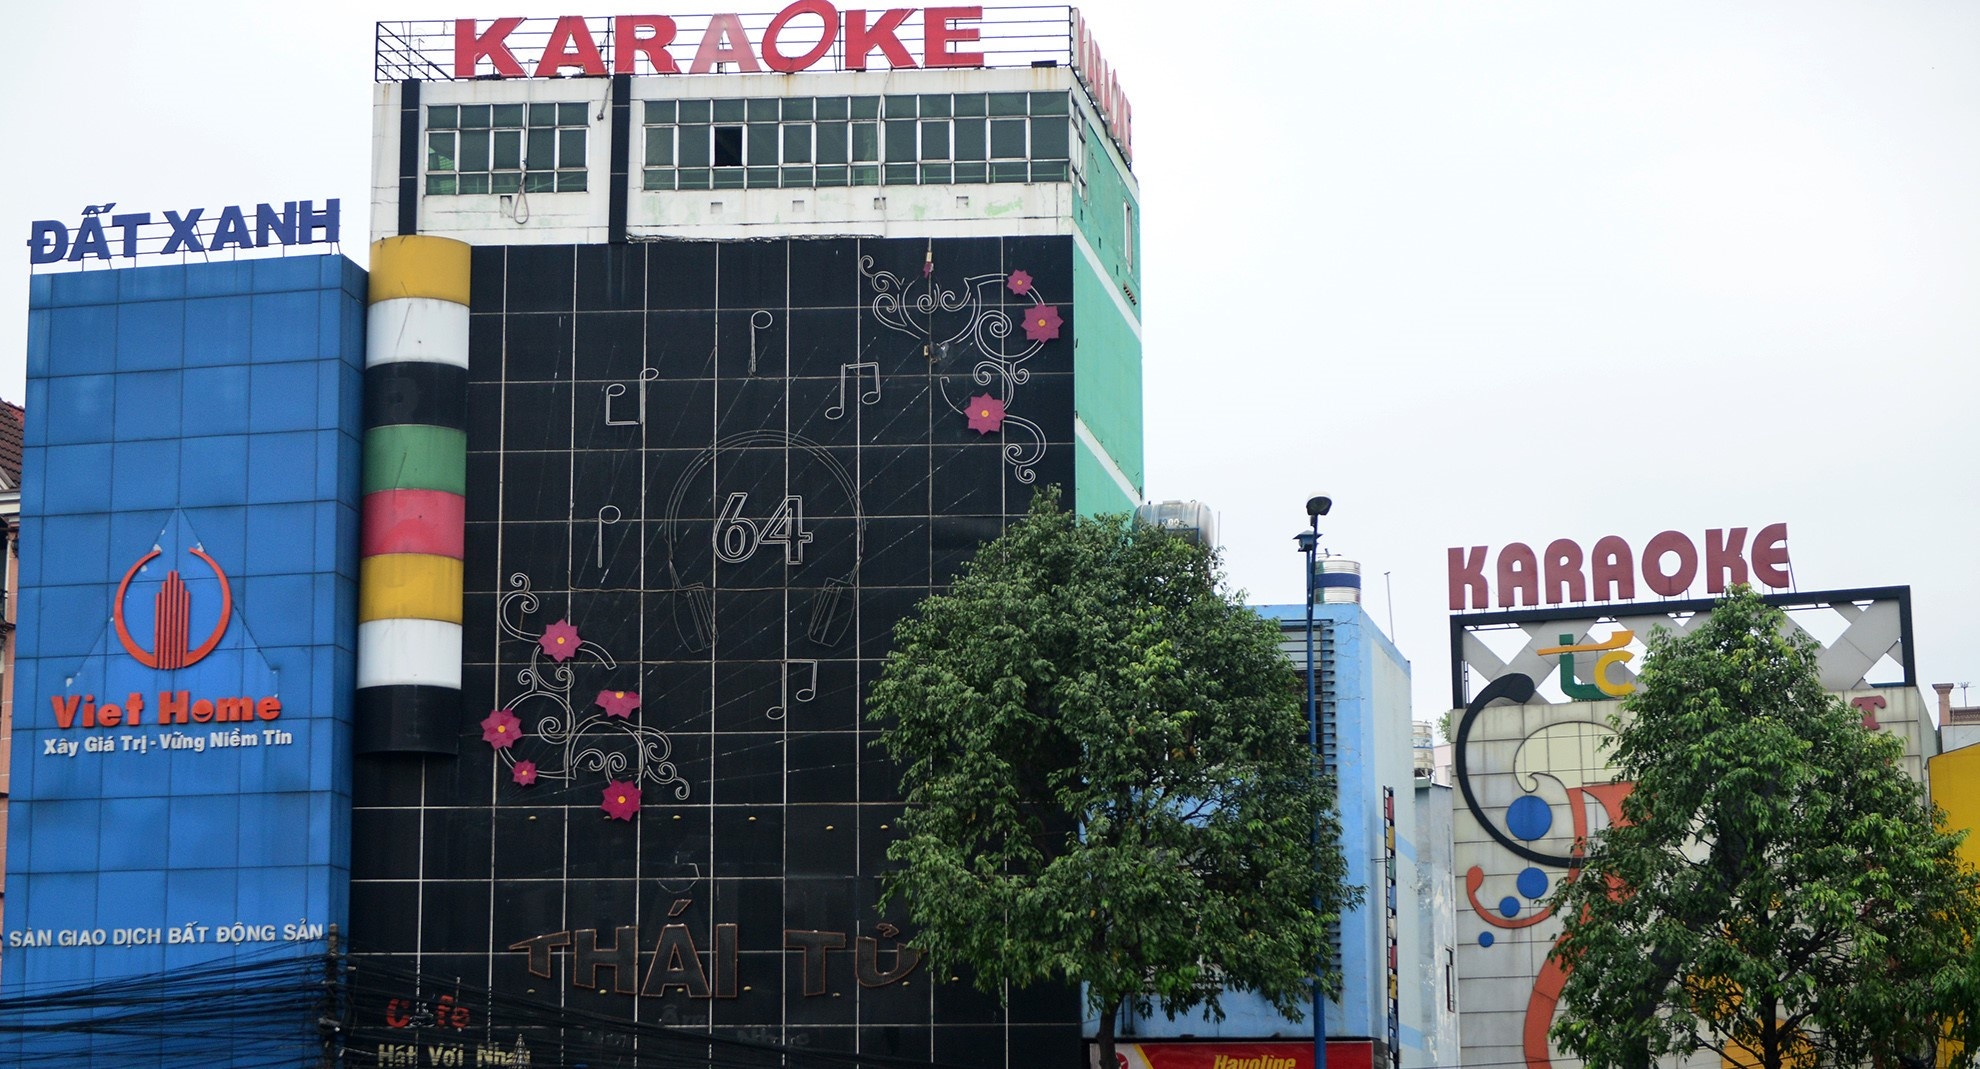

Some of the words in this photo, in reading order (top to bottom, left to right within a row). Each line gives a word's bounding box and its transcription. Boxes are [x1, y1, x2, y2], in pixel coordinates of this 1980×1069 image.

[453, 0, 985, 79] KARAOKE
[27, 203, 151, 265] ĐẤT
[160, 198, 341, 255] XANH
[713, 492, 814, 565] 64
[1447, 522, 1790, 611] KARAOKE
[43, 737, 79, 757] Xây
[84, 735, 115, 753] Giá
[120, 735, 148, 754] Trị
[159, 731, 205, 752] Vững
[210, 728, 258, 749] Niềm
[263, 729, 292, 746] Tin
[51, 692, 145, 729] Viet
[157, 690, 282, 724] Home
[58, 929, 107, 946] GIAO
[113, 928, 161, 948] DỊCH
[167, 921, 209, 945] BẤT
[216, 922, 276, 946] ĐỘNG
[283, 918, 324, 942] SẢN
[508, 899, 738, 998] THÁI
